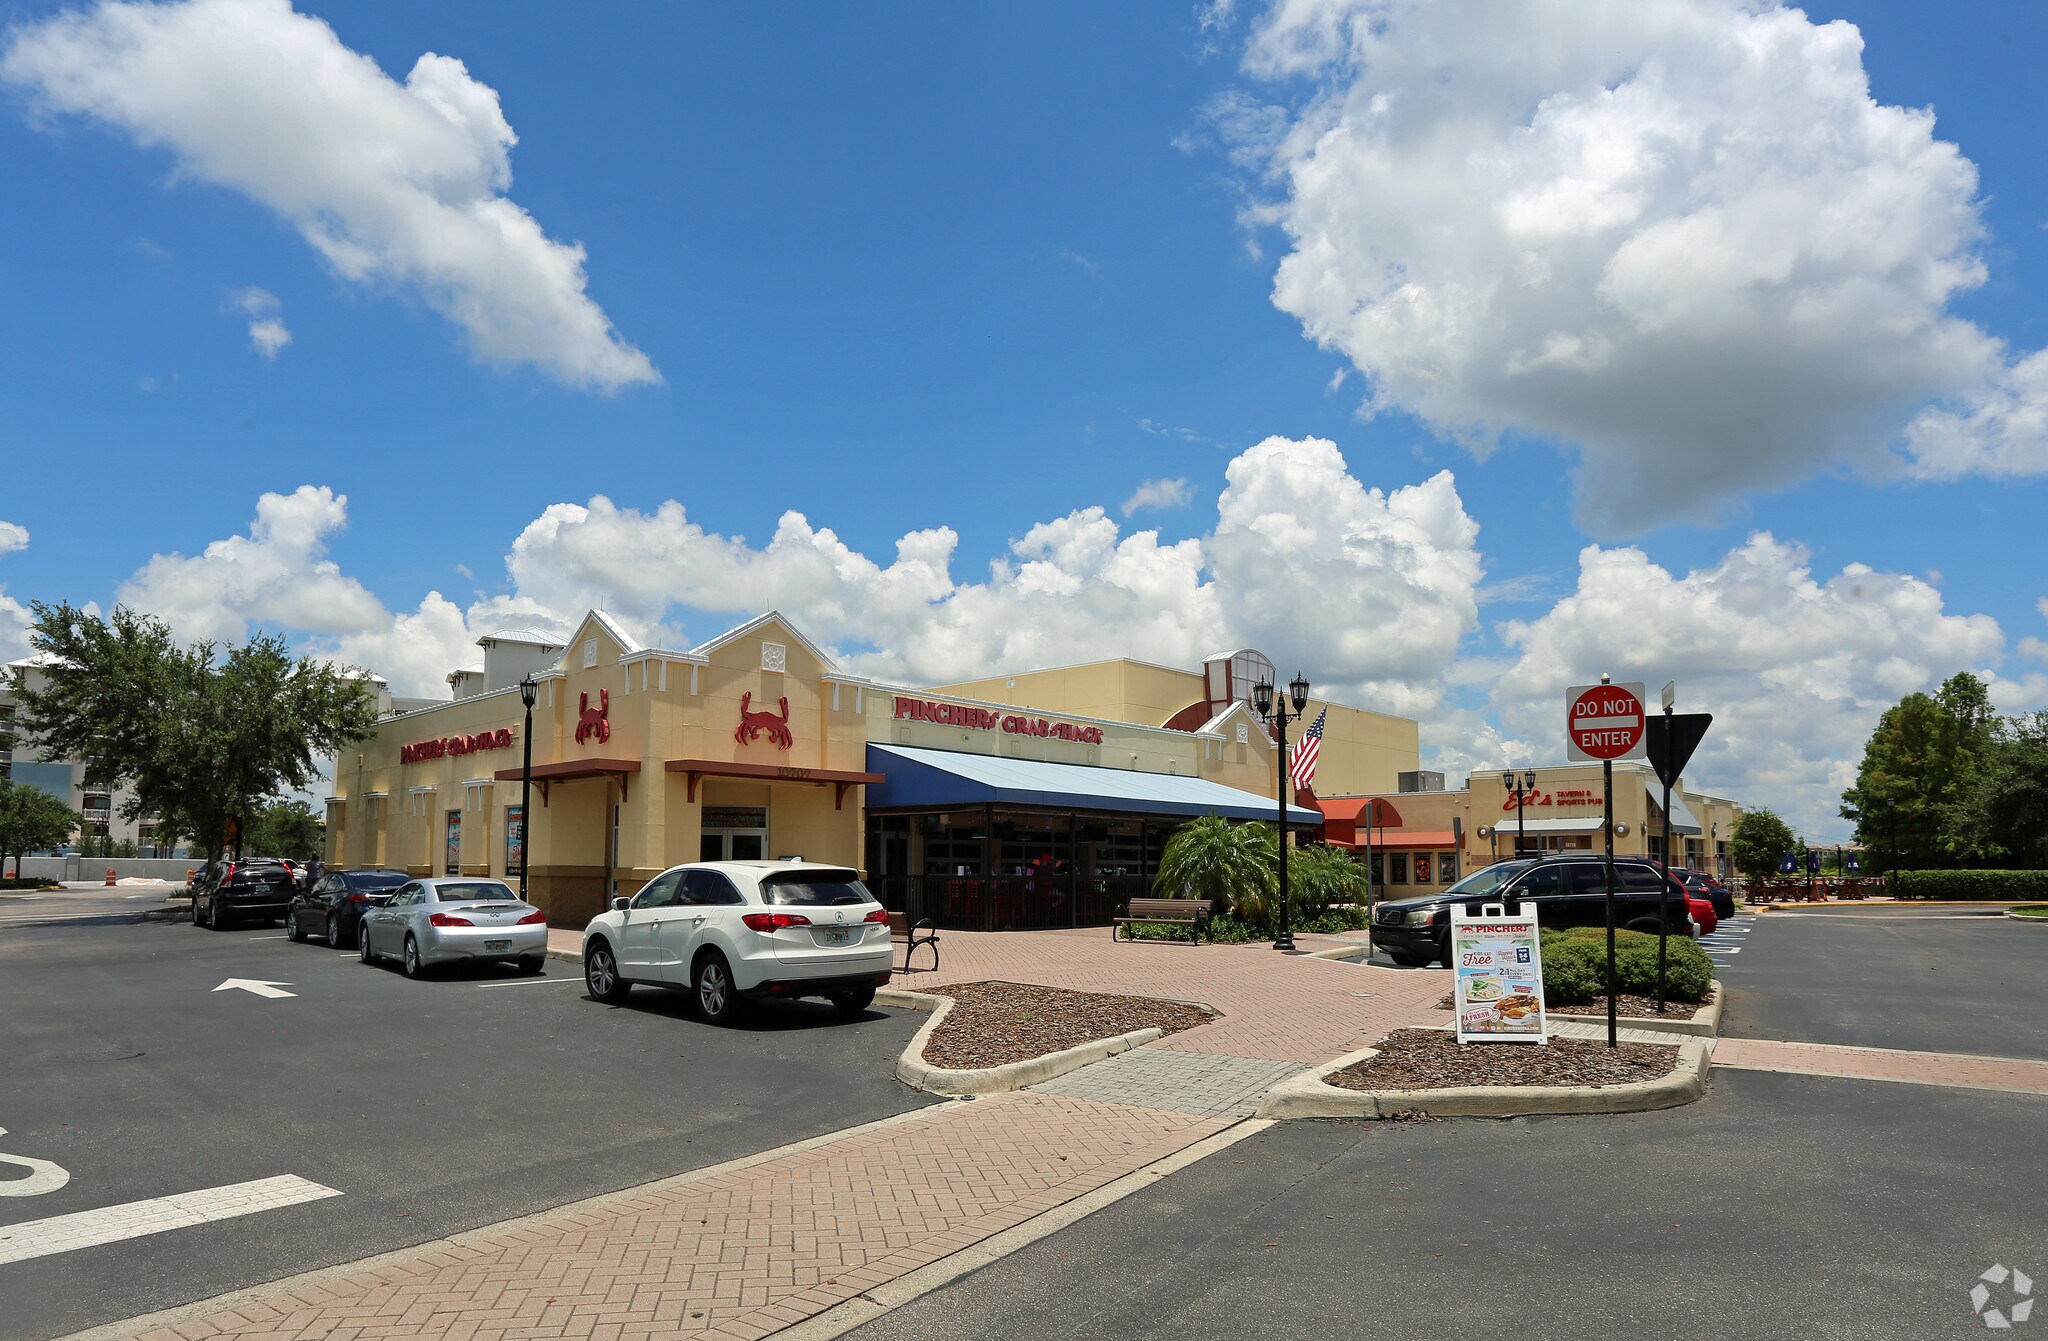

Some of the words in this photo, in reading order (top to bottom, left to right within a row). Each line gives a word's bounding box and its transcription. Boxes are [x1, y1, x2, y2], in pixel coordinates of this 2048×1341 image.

[894, 696, 999, 731] PINCHERS
[1576, 701, 1598, 716] DO
[1604, 699, 1635, 715] NOT
[1582, 731, 1632, 747] ENTER
[777, 766, 811, 779] 10707
[1502, 789, 1553, 811] Ed's
[1556, 799, 1586, 807] SPORTS
[1587, 798, 1603, 806] PUB
[1476, 925, 1529, 933] PINCHERS
[1463, 953, 1493, 966] Free
[1469, 1010, 1490, 1020] FRESH
